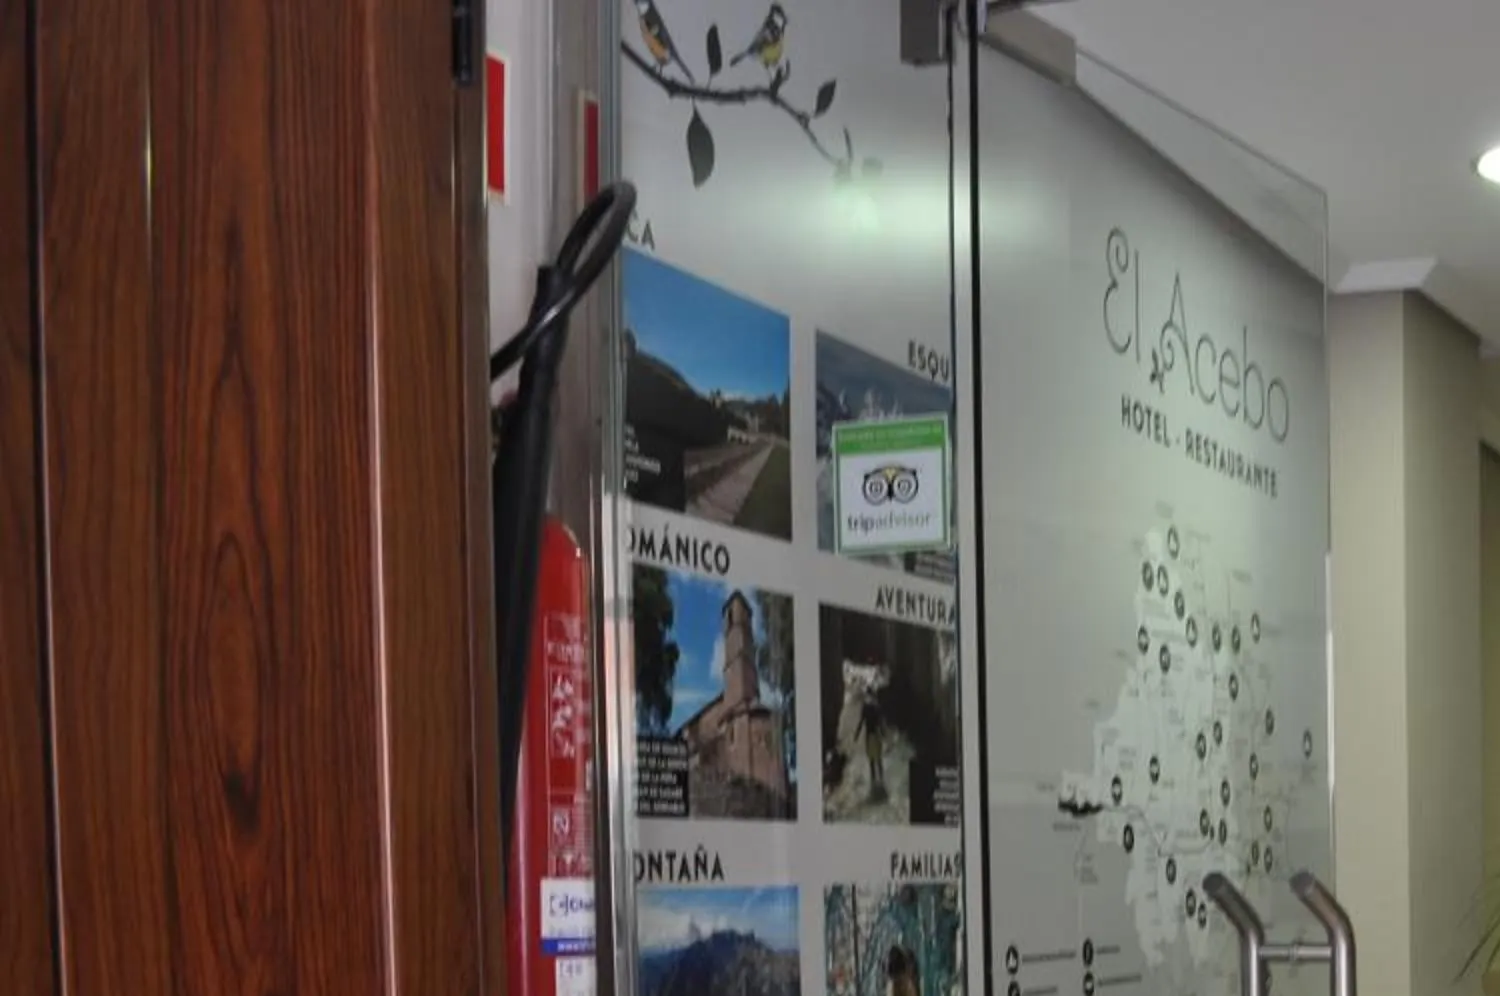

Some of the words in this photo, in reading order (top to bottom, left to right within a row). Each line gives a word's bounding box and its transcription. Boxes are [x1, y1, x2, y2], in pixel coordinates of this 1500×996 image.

[1103, 226, 1141, 363] El
[1156, 272, 1290, 443] Acebo
[1121, 394, 1171, 448] HOTEL
[1185, 427, 1278, 499] RESTAURANTE
[847, 510, 931, 533] tripadvisor
[630, 523, 731, 576] MÁNICO
[876, 585, 956, 625] AVENTURA
[890, 852, 961, 879] FAMILIAS
